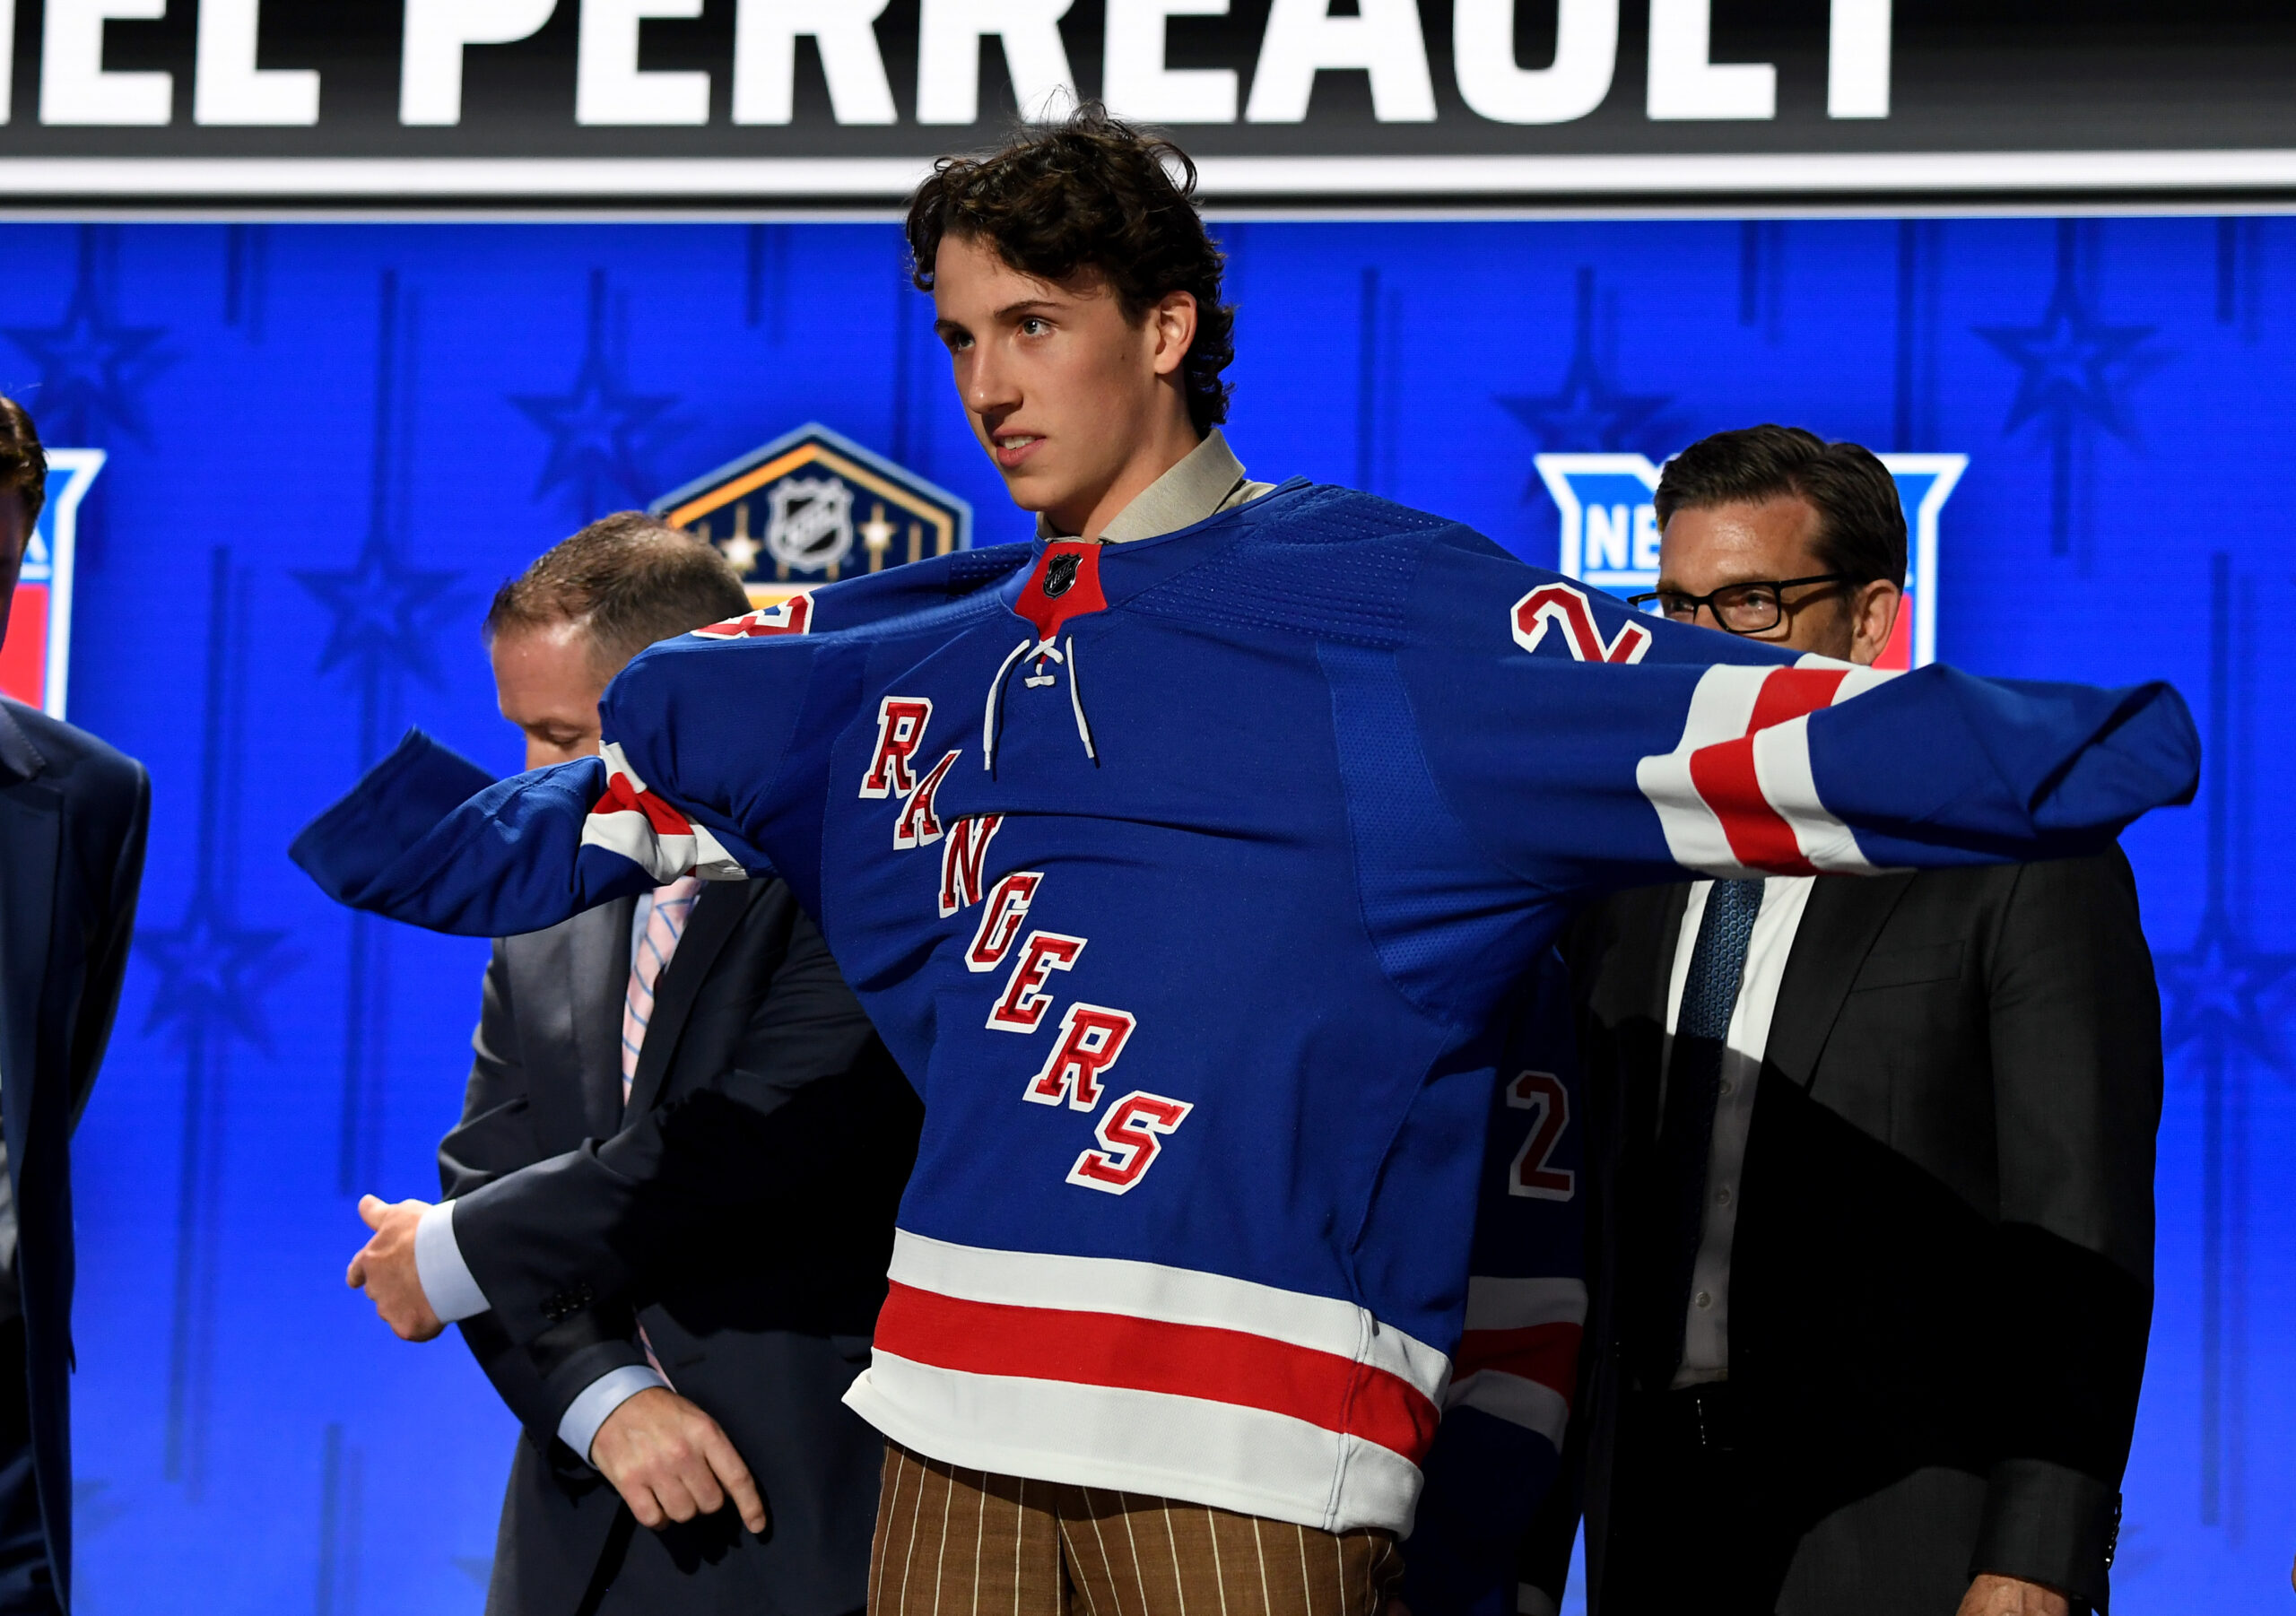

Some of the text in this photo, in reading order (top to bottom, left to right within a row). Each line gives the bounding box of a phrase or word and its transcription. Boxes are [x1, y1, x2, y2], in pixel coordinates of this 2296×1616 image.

[0, 0, 320, 126] EL
[1586, 504, 1661, 569] NE
[1510, 582, 1652, 665] 2
[858, 695, 1194, 1195] RANGERS
[1507, 1070, 1575, 1202] 2
